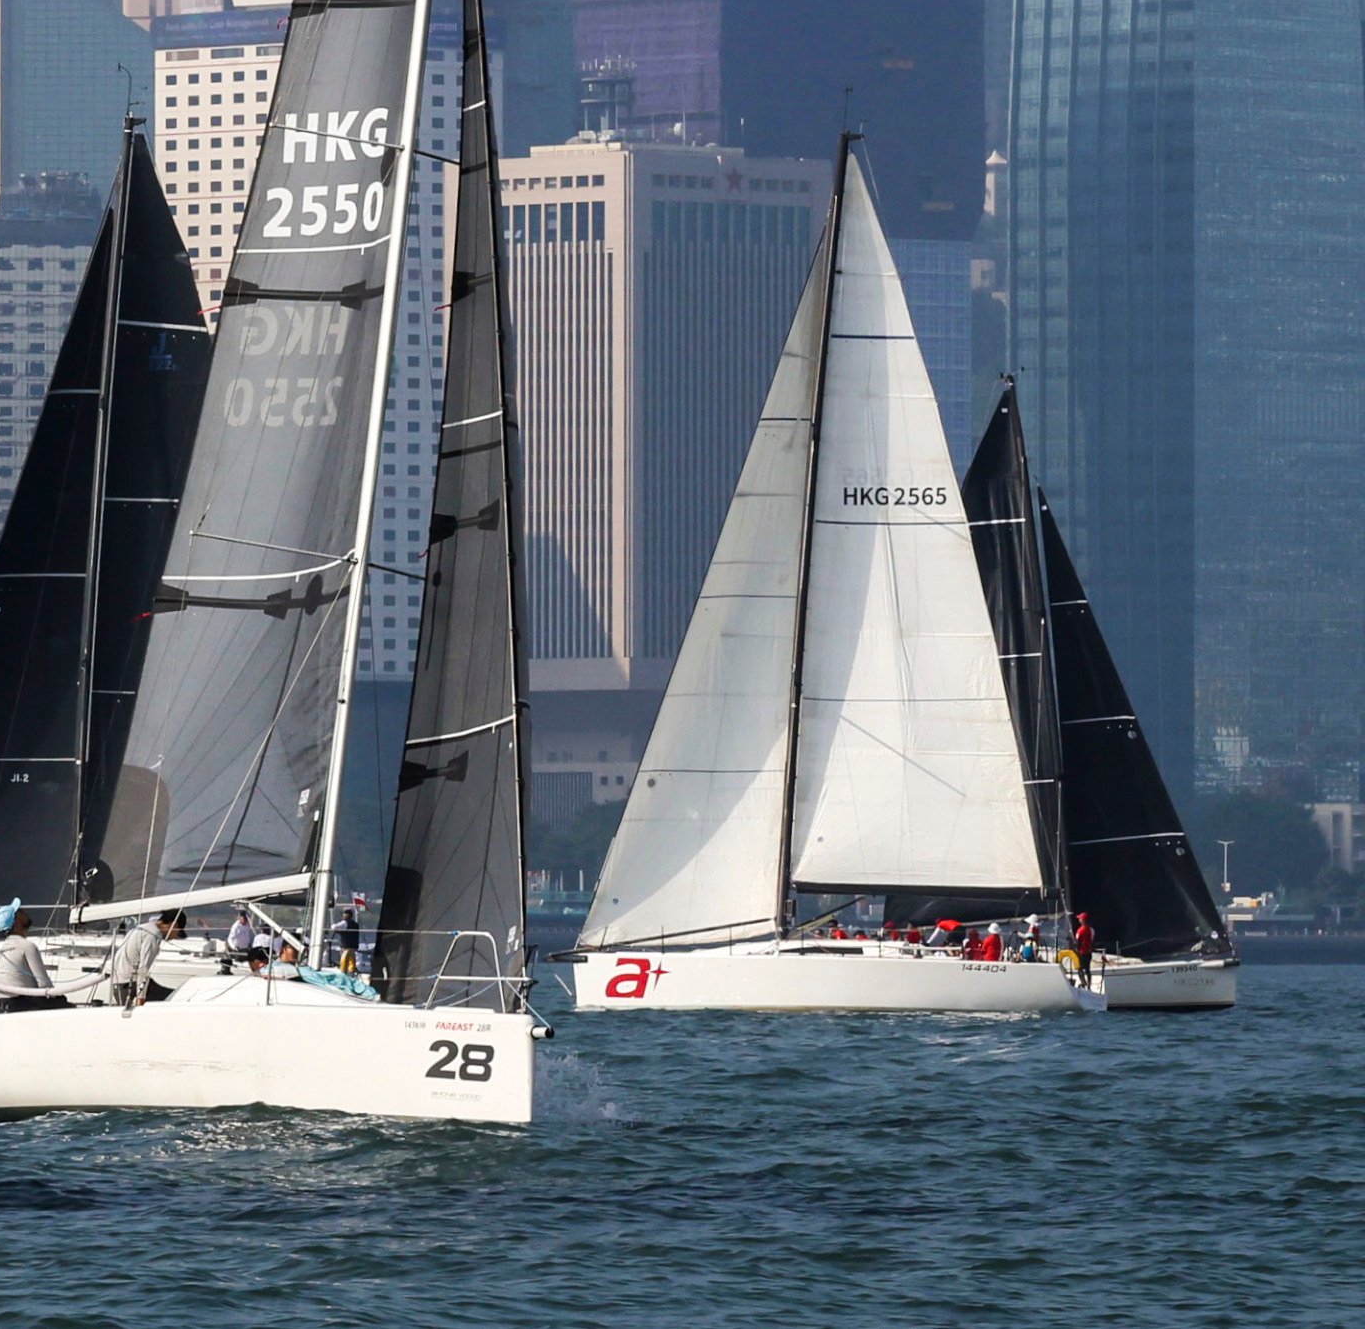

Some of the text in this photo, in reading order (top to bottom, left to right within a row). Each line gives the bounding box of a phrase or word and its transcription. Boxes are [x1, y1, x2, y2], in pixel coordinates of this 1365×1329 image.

[283, 108, 388, 163] HKG
[263, 182, 384, 237] 2550
[843, 487, 947, 505] HKG 2565
[962, 964, 1007, 973] 144404
[435, 1022, 474, 1031] FAREAST
[476, 1023, 492, 1032] 28R
[425, 1039, 494, 1082] 28
